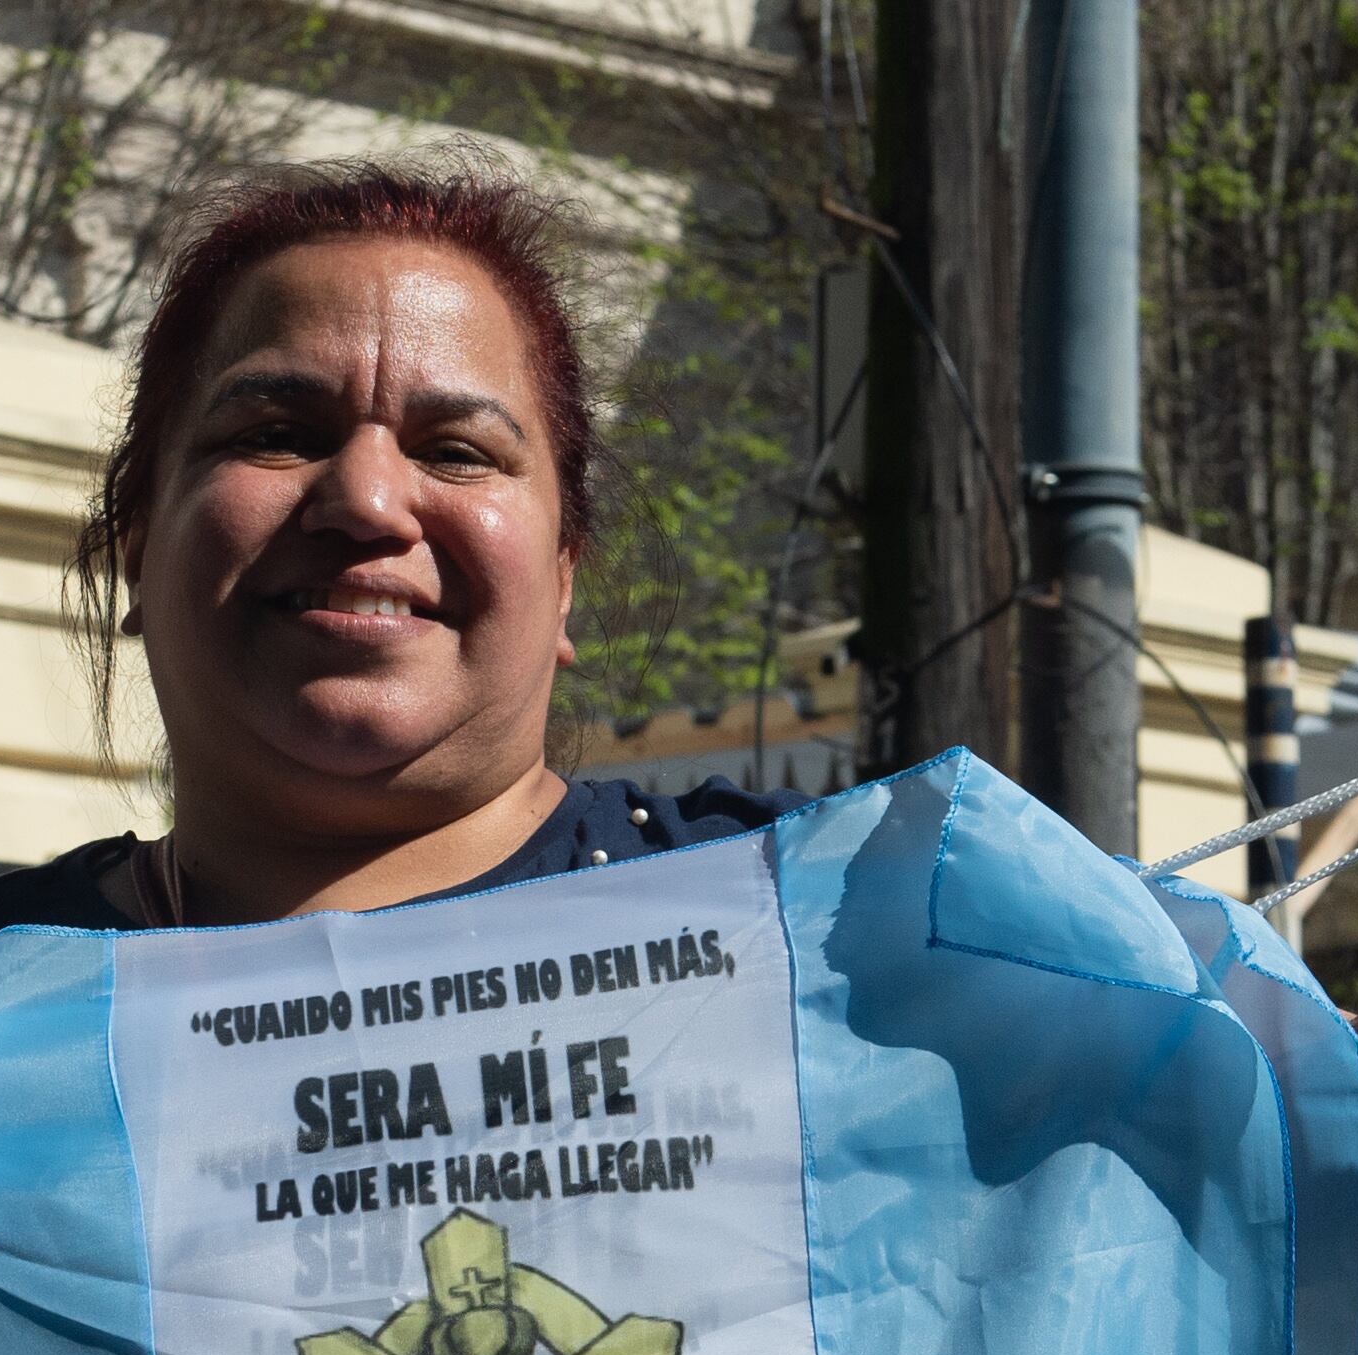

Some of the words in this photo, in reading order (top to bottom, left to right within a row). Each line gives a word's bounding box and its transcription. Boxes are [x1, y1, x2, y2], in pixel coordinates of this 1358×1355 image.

[361, 980, 424, 1028] MIS
[430, 966, 508, 1018] PIES
[514, 958, 563, 1005] NO
[569, 944, 640, 997] DEN
[644, 926, 736, 984] MÁS,
[293, 1062, 454, 1155] SERA
[479, 1030, 554, 1130] MÍ
[566, 1036, 637, 1120] FE
[255, 1178, 303, 1223] LA
[311, 1166, 380, 1217] QUE
[386, 1159, 438, 1209] ME
[444, 1149, 552, 1204] HAGA
